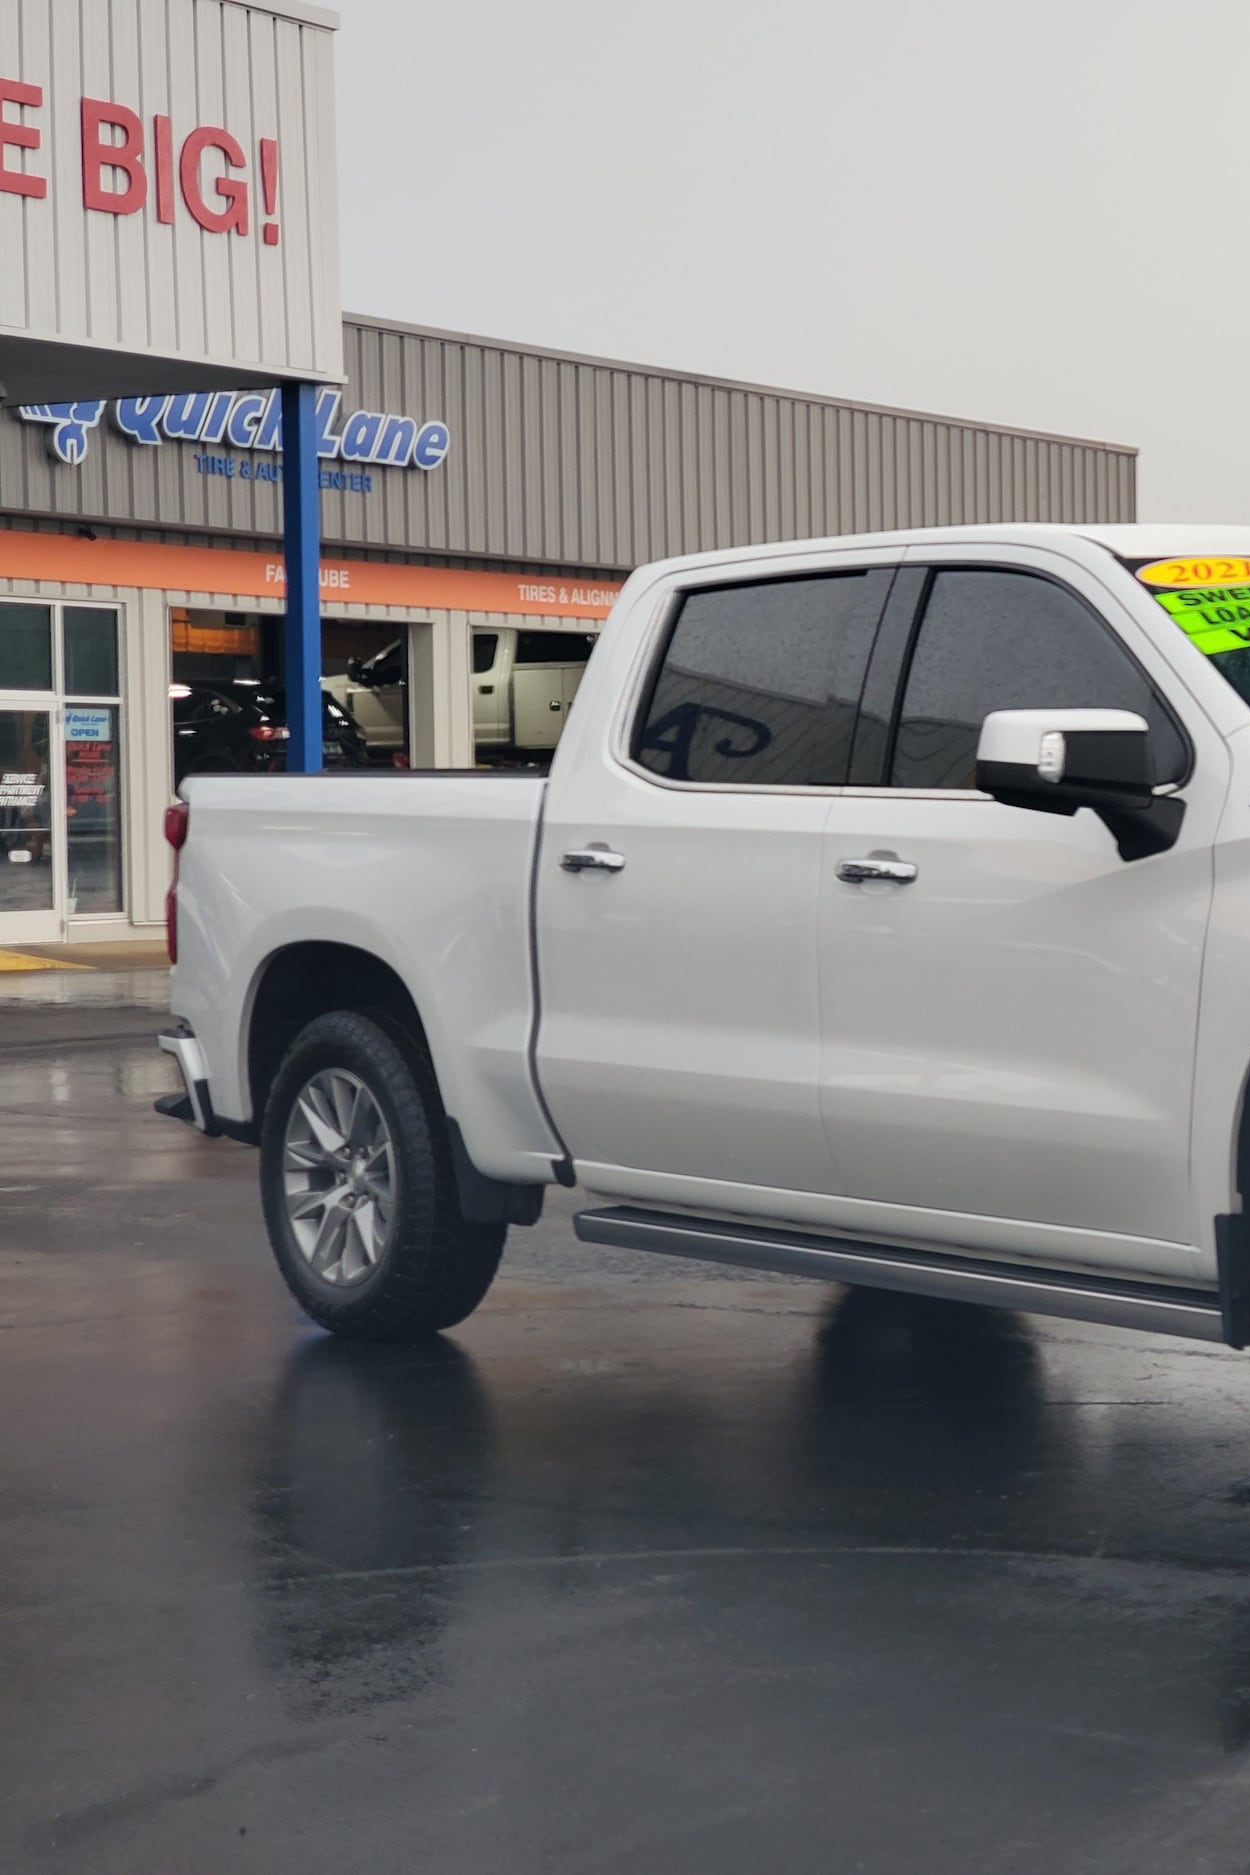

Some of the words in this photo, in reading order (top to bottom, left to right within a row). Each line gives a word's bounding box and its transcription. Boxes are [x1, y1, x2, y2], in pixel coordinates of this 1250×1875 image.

[81, 96, 280, 246] BIG!
[317, 388, 450, 470] Lane
[195, 454, 235, 477] TIRE
[240, 460, 254, 480] &
[256, 462, 284, 482] AU
[318, 470, 372, 492] ENTER
[265, 564, 286, 583] FA
[318, 568, 350, 588] UBE
[517, 584, 556, 603] TIRES
[559, 587, 569, 604] &
[571, 588, 621, 607] ALIGNM
[71, 728, 99, 737] OPEN
